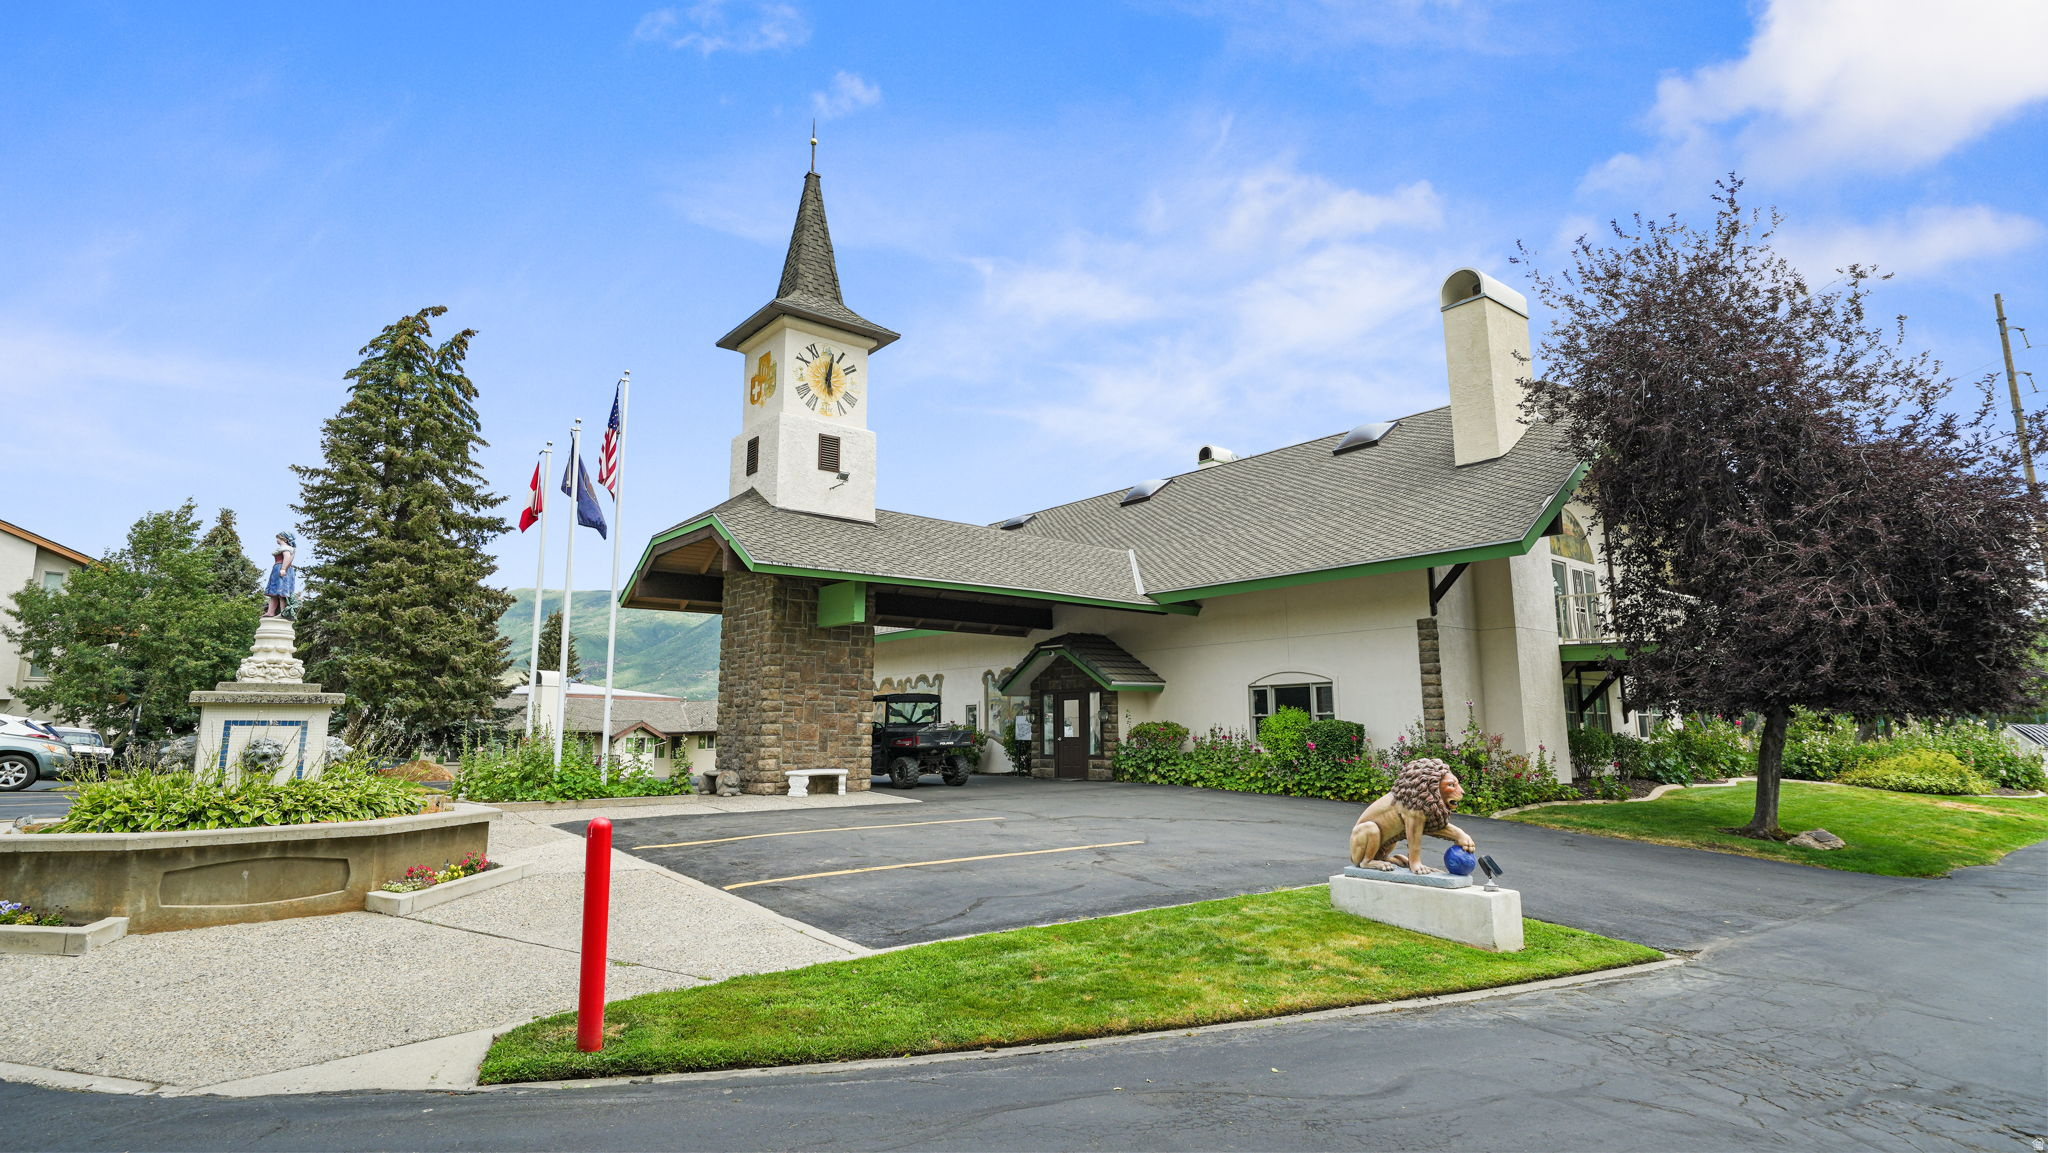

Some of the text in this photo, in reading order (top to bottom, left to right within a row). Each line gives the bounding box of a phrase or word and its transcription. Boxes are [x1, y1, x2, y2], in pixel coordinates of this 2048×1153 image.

[795, 352, 811, 367] X
[805, 343, 820, 361] XI
[843, 364, 857, 376] II
